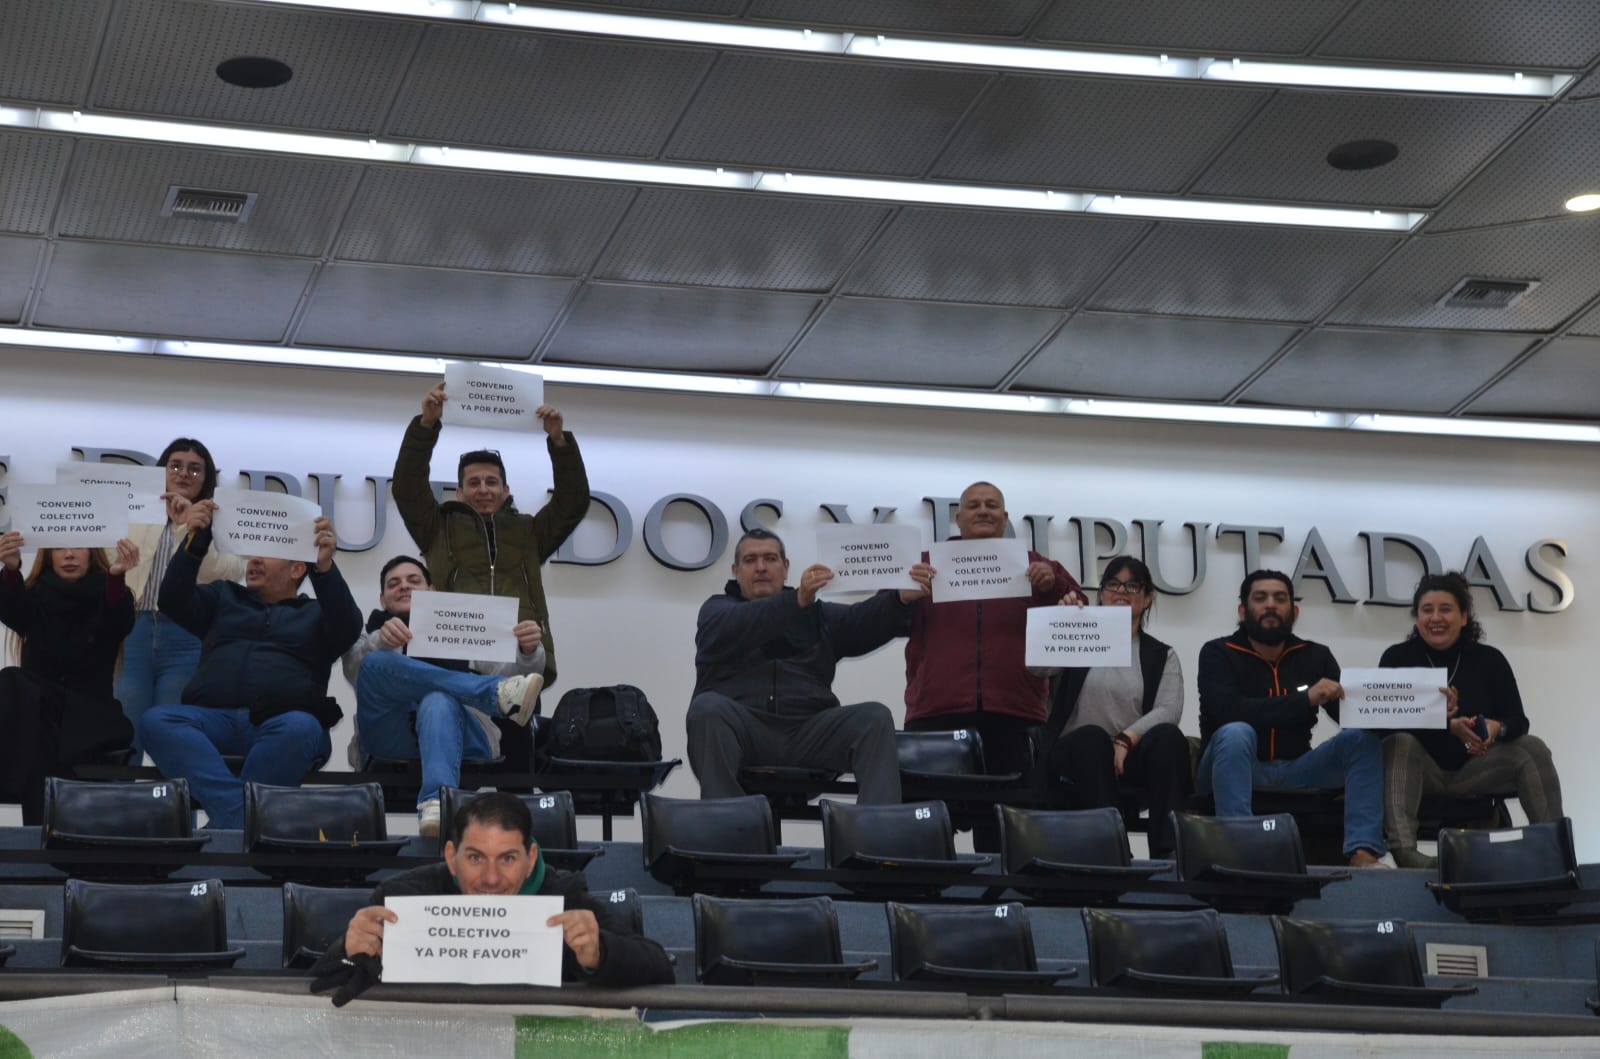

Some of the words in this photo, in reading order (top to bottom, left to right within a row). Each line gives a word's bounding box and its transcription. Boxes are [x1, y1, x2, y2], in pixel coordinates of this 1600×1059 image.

[467, 381, 513, 391] “CONVENIO
[469, 393, 515, 403] COLECTIVO
[474, 405, 491, 413] POR
[493, 407, 524, 415] FAVOR”
[236, 508, 287, 518] “CONVENIO
[237, 520, 288, 530] COLECTIVO
[243, 533, 261, 541] POR
[264, 535, 298, 544] FAVOR”
[841, 543, 889, 551] “CONVENIO
[845, 555, 892, 564] COLECTIVO
[952, 555, 997, 563] “CONVENIO
[872, 567, 903, 575] FAVOR”
[955, 566, 1001, 575] COLECTIVO
[981, 577, 1012, 585] FAVOR”
[434, 611, 484, 619] “CONVENIO
[436, 623, 486, 632] COLECTIVO
[462, 638, 496, 646] FAVOR”
[1366, 694, 1415, 702] COLECTIVO
[153, 785, 167, 798] 61
[539, 796, 555, 809] 63
[915, 808, 931, 820] 65
[1262, 819, 1276, 831] 67
[190, 883, 207, 896] 43
[610, 890, 626, 903] 45
[424, 906, 507, 917] “CONVENIO
[994, 905, 1009, 918] 47
[428, 927, 510, 938] COLECTIVO
[1377, 921, 1393, 934] 49
[415, 948, 434, 957] YA
[439, 948, 468, 958] POR
[473, 949, 527, 959] FAVOR”
